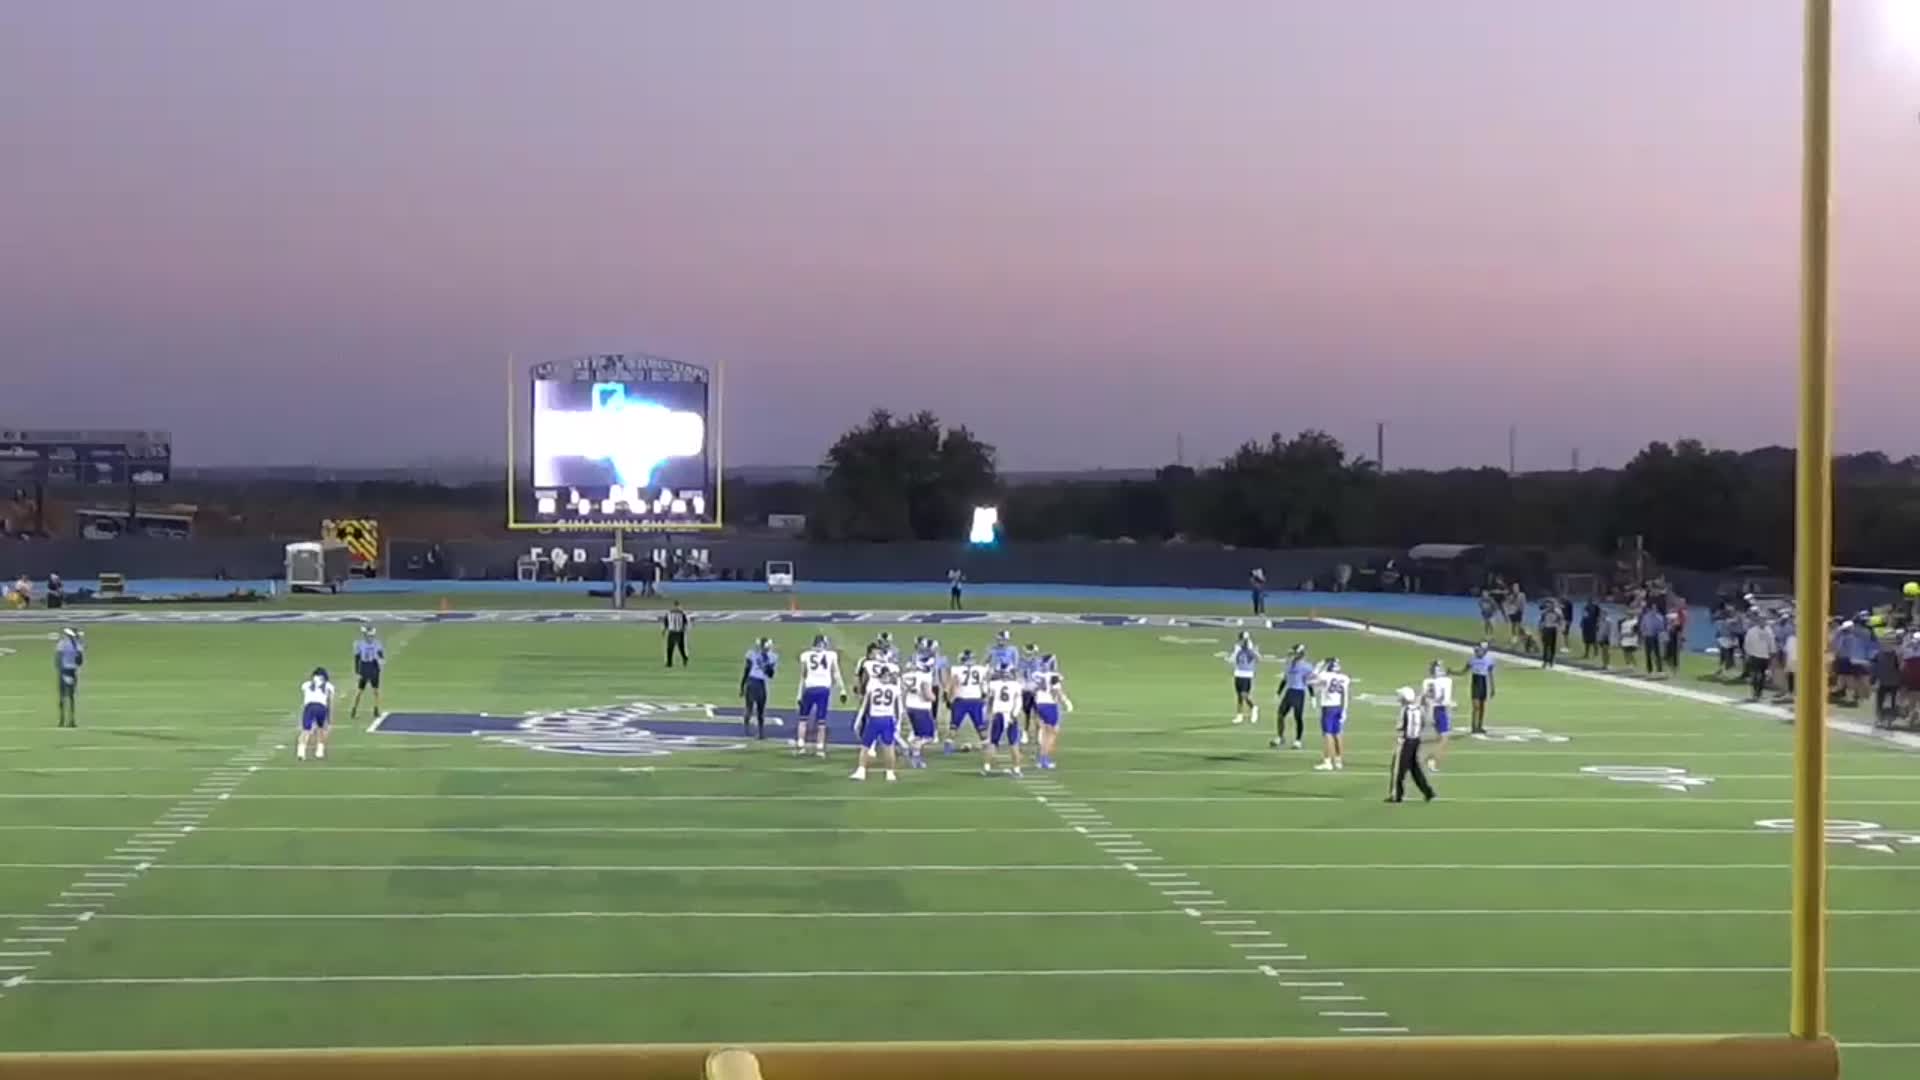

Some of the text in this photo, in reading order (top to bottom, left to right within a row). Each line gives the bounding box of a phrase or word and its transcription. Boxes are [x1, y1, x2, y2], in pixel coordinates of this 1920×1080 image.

[809, 653, 828, 671] 54
[961, 670, 980, 686] 79
[872, 687, 893, 706] 29
[999, 686, 1010, 702] 6
